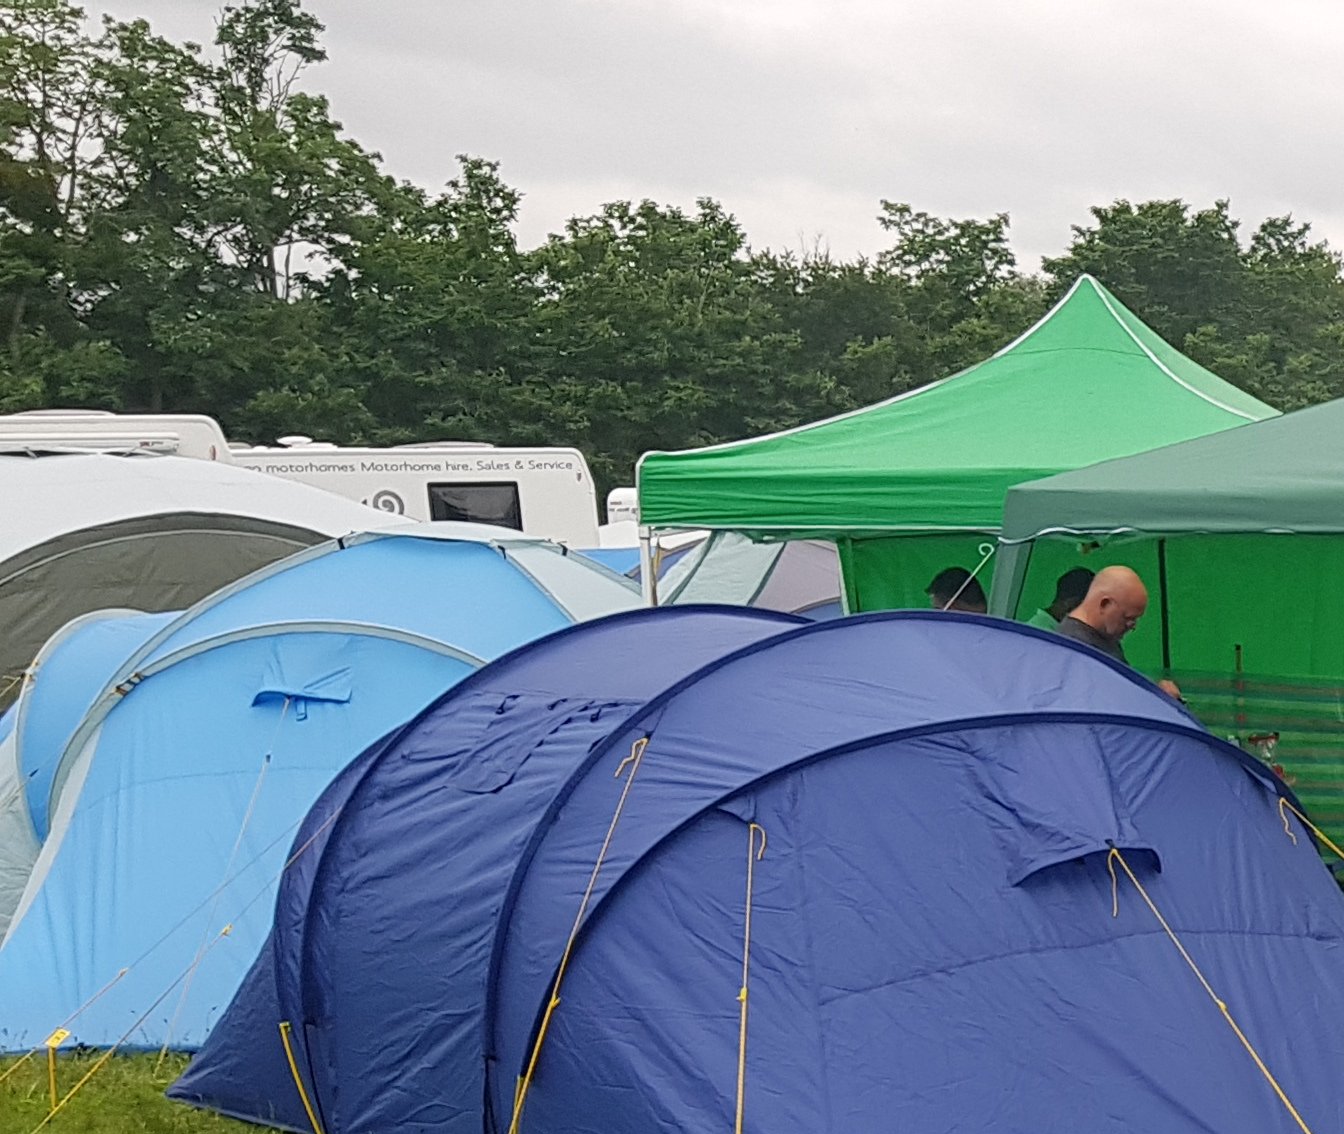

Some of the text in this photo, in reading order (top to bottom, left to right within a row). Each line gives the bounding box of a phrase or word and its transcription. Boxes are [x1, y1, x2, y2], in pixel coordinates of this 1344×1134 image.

[266, 462, 356, 473] motorhomes
[360, 461, 442, 472] Motorhome
[476, 460, 510, 471] Sales
[514, 460, 524, 470] &
[528, 460, 573, 470] Service
